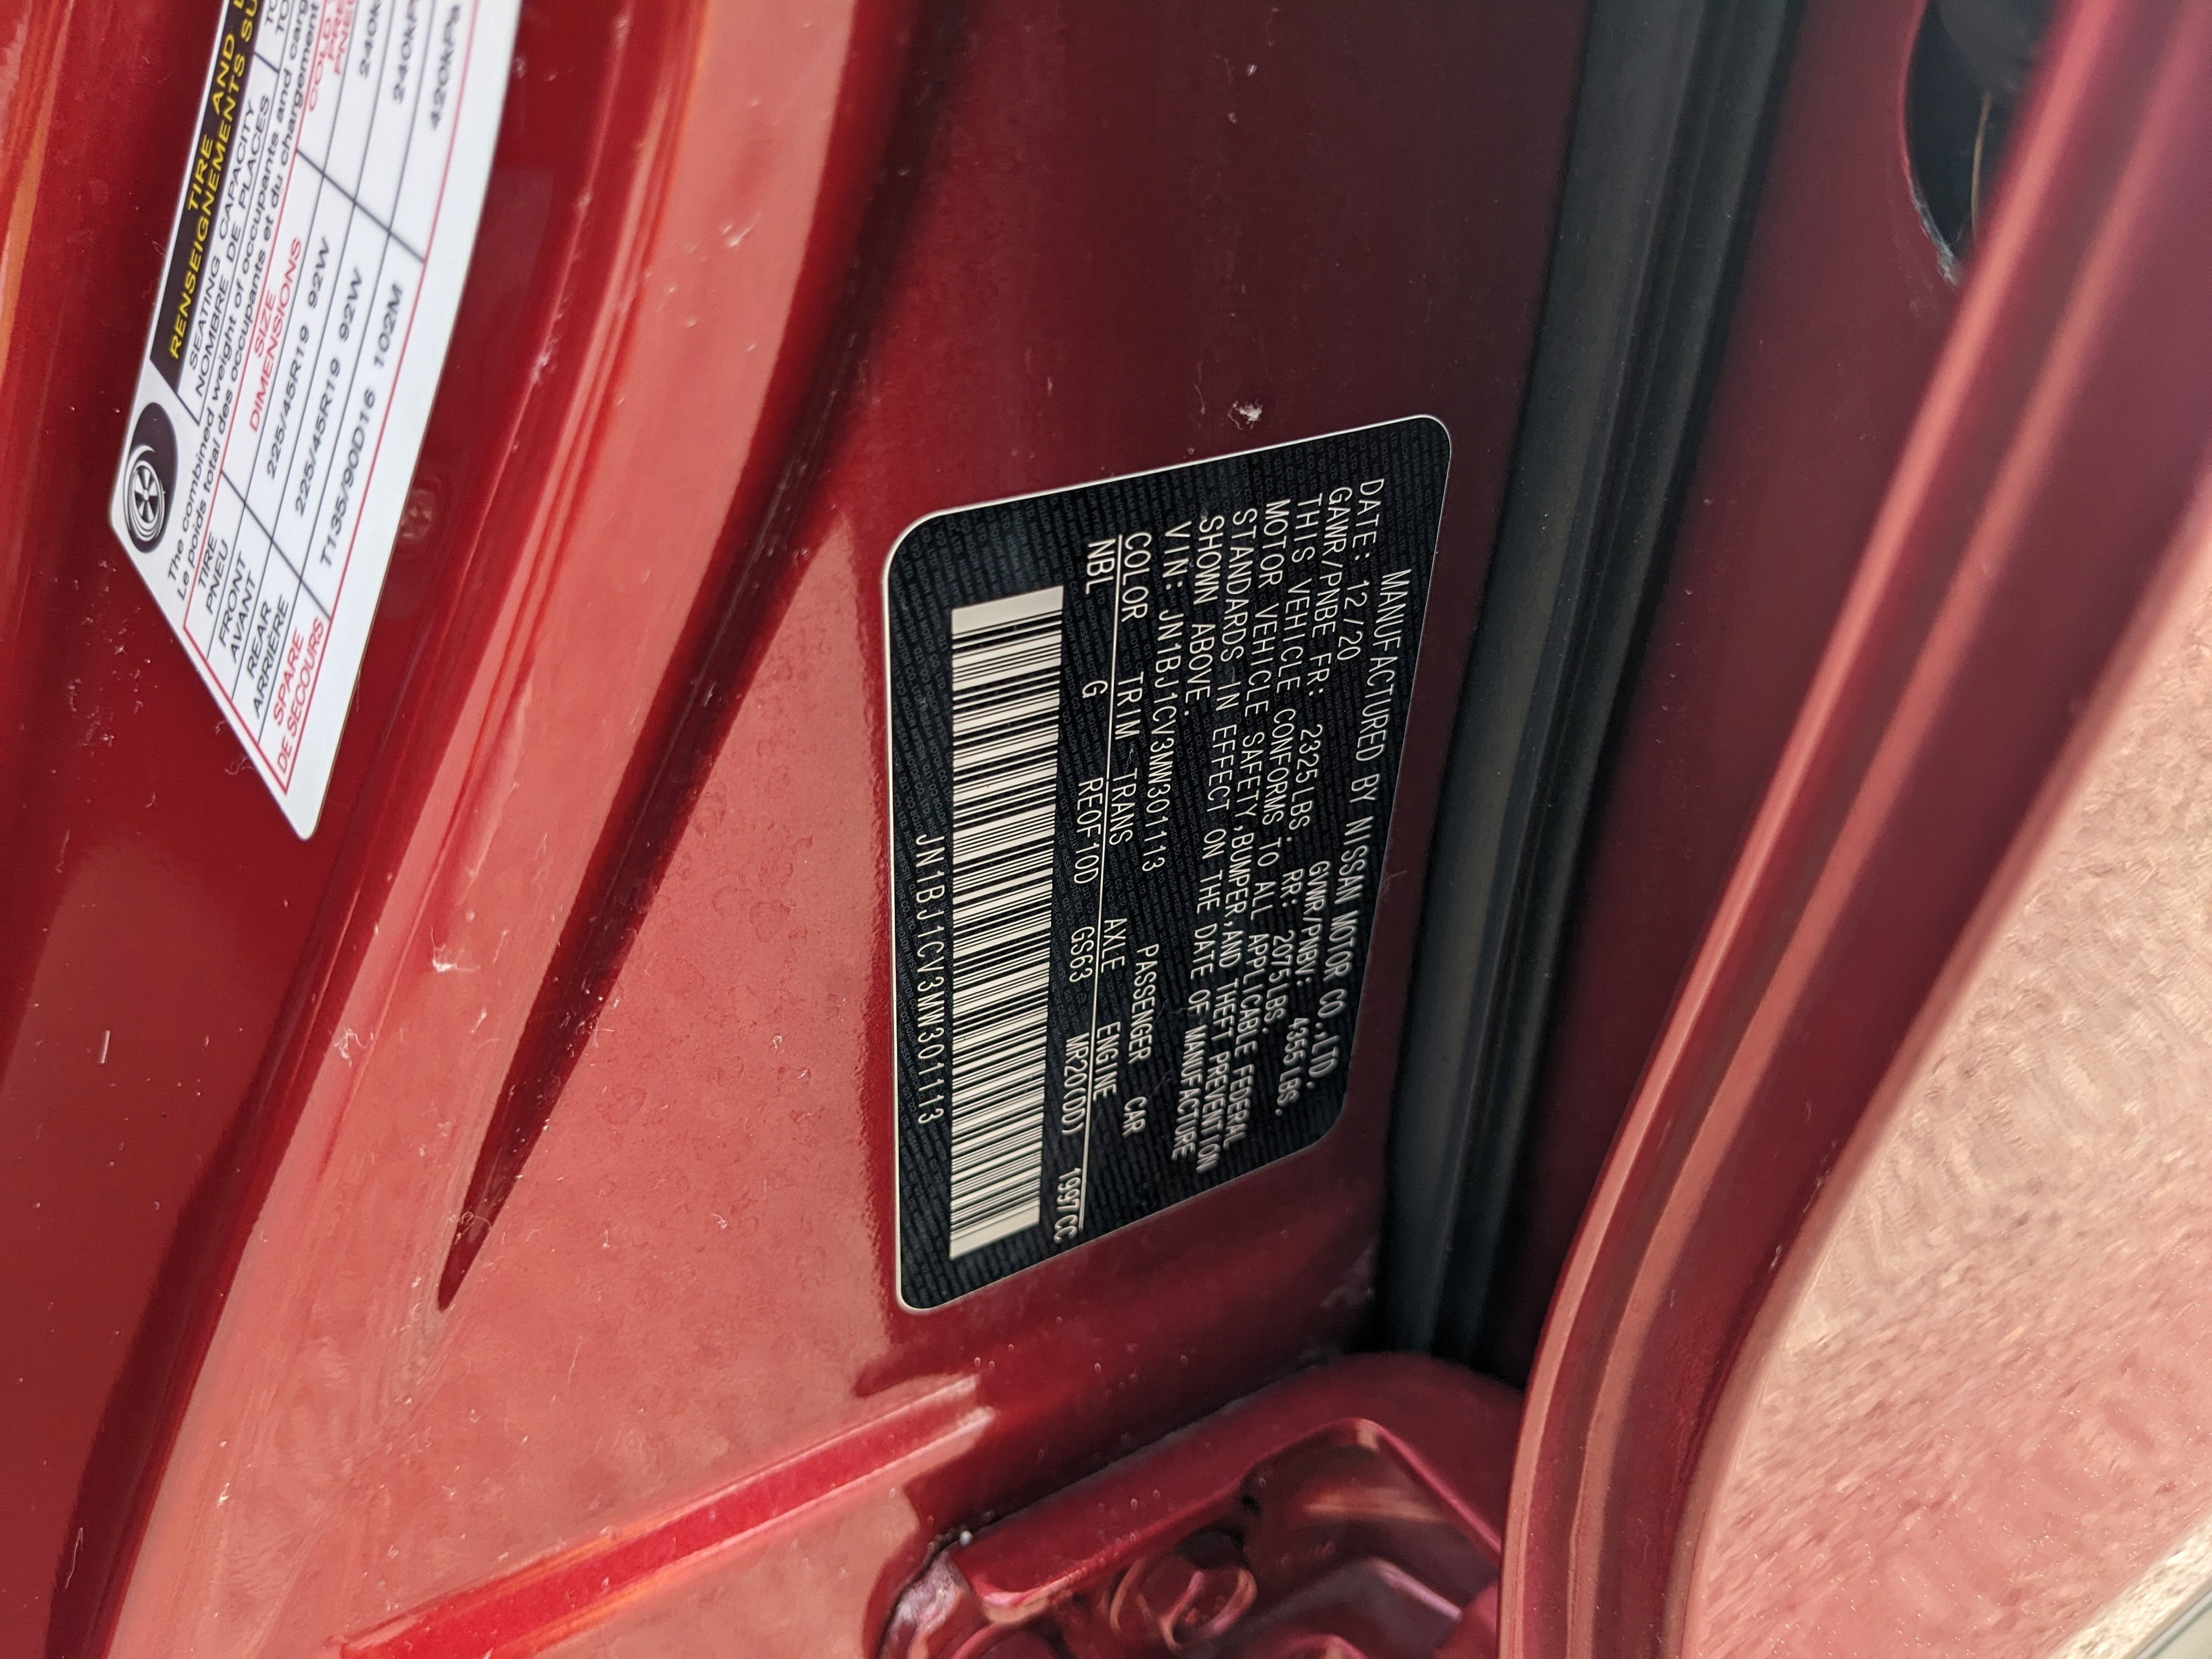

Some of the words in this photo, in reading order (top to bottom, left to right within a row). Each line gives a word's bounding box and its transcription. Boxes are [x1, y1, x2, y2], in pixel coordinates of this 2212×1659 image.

[188, 134, 213, 210] TIRE
[212, 33, 235, 115] AND
[168, 53, 245, 359] RENSEIGNEMENTS
[190, 255, 221, 370] SEATING
[219, 100, 255, 240] CAPACITY
[195, 275, 229, 397] NOMBRE
[226, 222, 241, 263] DE
[238, 94, 269, 209] PLACES
[168, 539, 184, 582] The
[183, 407, 215, 532] combined
[212, 314, 238, 401] weight
[234, 278, 245, 309] of
[242, 132, 279, 275] occupants
[276, 68, 292, 123] and
[177, 571, 190, 601] Le
[187, 499, 207, 569] poids
[203, 438, 221, 493] total
[218, 388, 233, 435] des
[231, 249, 266, 382] occupants
[263, 215, 274, 242] et
[271, 174, 284, 208] du
[281, 3, 319, 166] chargement
[249, 238, 301, 433] DIMENSIONS
[255, 289, 276, 357] SIZE
[267, 325, 309, 481] 225/45R19
[307, 236, 330, 309] 92W
[295, 357, 341, 517] 225/45R19
[338, 266, 363, 342] 92W
[319, 387, 376, 568] T135/90D16
[374, 282, 403, 369] 102M
[198, 531, 218, 589] TIRE
[1161, 520, 1192, 590] VIN:
[1193, 515, 1224, 605] SHOWN
[1257, 498, 1291, 589] MOTOR
[1291, 492, 1323, 563] THIS
[1311, 486, 1352, 638] GAWR/PNBE
[1351, 478, 1385, 560] DATE:
[205, 538, 228, 615] PNEU
[218, 550, 247, 648] FRONT
[1085, 537, 1116, 595] NBL
[1121, 532, 1152, 622] COLOR
[1220, 507, 1257, 662] STANDARDS
[230, 569, 256, 664] AVANT
[246, 600, 272, 680] REAR
[253, 592, 289, 719] ARRIÈRE
[1244, 602, 1279, 717] VEHICLE
[1276, 578, 1312, 693] VEHICLE
[1336, 579, 1369, 661] 12/20
[273, 627, 304, 727] SPARE
[276, 735, 293, 775] DE
[287, 616, 324, 738] SECOURS
[1081, 679, 1108, 698] G
[1114, 670, 1144, 740] TRIM
[1183, 623, 1216, 716] ABOVE.
[1215, 681, 1242, 711] IN
[1306, 652, 1331, 696] FR:
[1355, 568, 1412, 761] MANUFACTURED
[1141, 609, 1184, 872] JN1BJ1CV3MW301113
[1206, 724, 1237, 812] EFFECT
[1261, 708, 1296, 825] CONFORMS
[1108, 767, 1138, 845] TRANS
[1349, 773, 1379, 803] BY
[1201, 828, 1227, 860] ON
[1256, 836, 1282, 867] TO
[1279, 868, 1304, 907] RR:
[1334, 815, 1373, 904] NISSAN
[1196, 868, 1223, 914] THE
[1250, 881, 1276, 920] ALL
[1294, 860, 1330, 985] GVWR/PNBV:
[915, 833, 945, 1124] JN1BJ1CV3MW301113
[1069, 926, 1095, 983] GS63
[1100, 917, 1127, 973] AXLE
[1190, 922, 1217, 979] DATE
[1323, 910, 1358, 981] MOTOR
[1128, 943, 1159, 1063] PASSENGER
[1187, 989, 1211, 1014] OF
[1211, 977, 1238, 1040] THEFT
[1234, 933, 1269, 1057] APPLICABLE
[1060, 1031, 1090, 1135] MR20(DD)
[1092, 1020, 1121, 1101] ENGINE
[1171, 1024, 1207, 1159] MANUFACTURE
[1223, 1063, 1253, 1147] FEDERAL
[1122, 1096, 1147, 1135] CAR
[1196, 1050, 1230, 1170] PREVENTION
